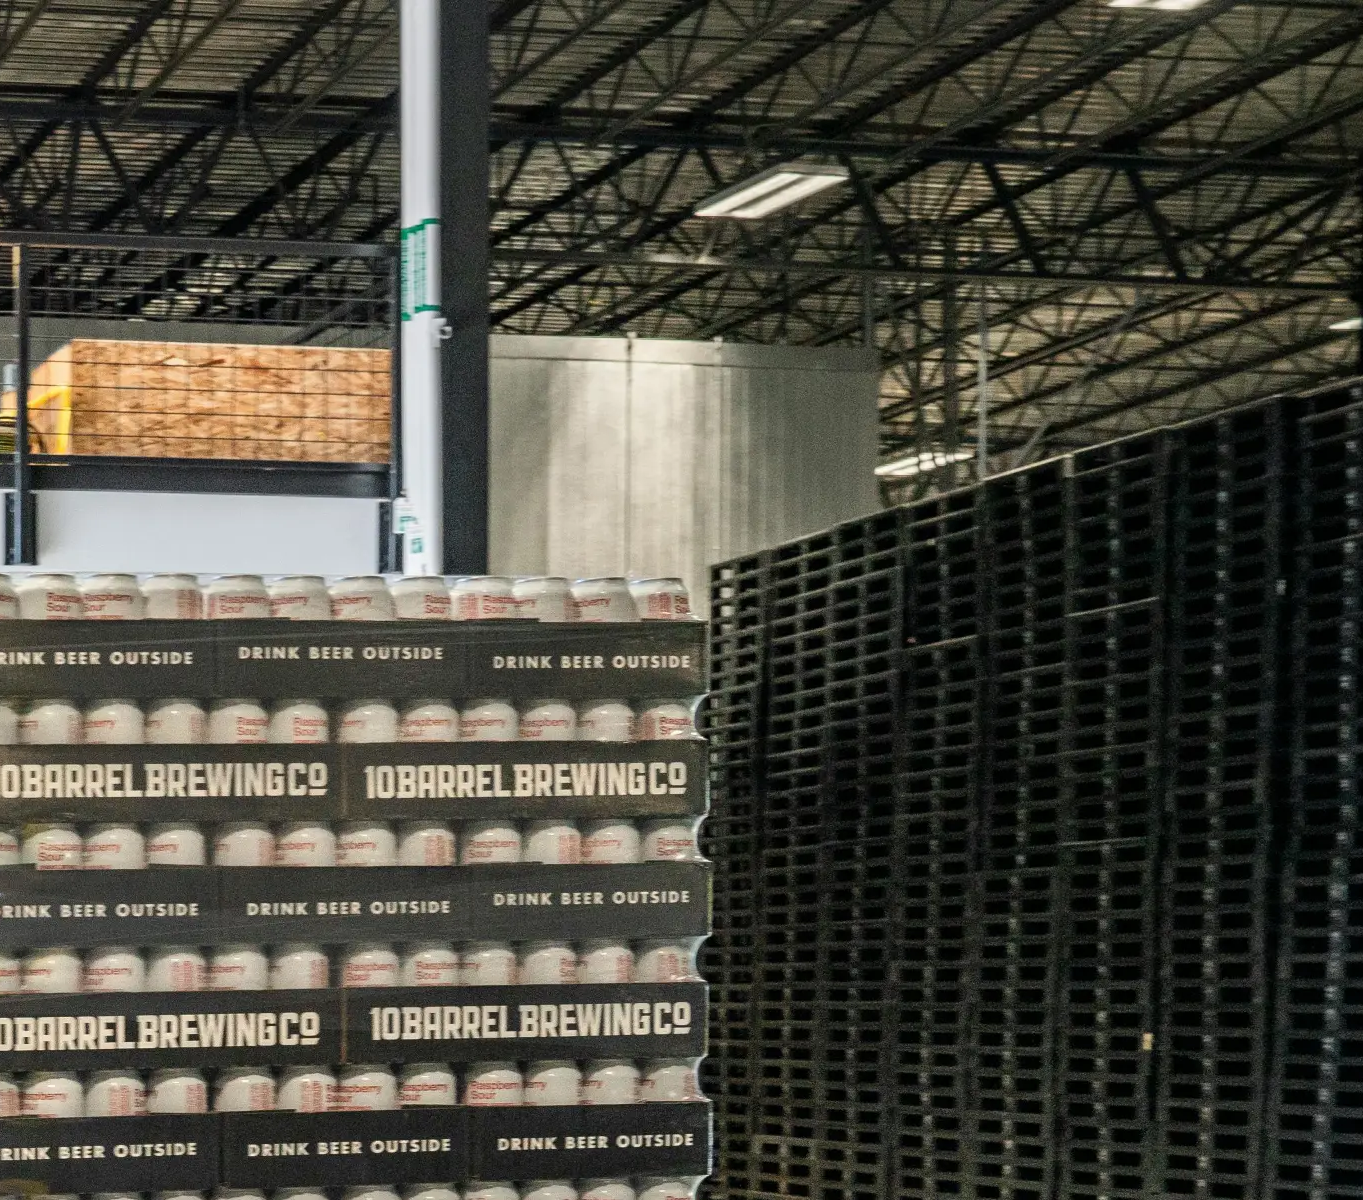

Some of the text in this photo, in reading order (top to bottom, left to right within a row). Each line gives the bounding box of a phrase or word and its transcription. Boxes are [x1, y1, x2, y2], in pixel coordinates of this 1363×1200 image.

[54, 651, 101, 665] BEER
[109, 651, 193, 665] OUTSIDE
[238, 646, 443, 660] DRINK BEER OUTSIDE
[493, 654, 691, 669] DRINK BEER OUTSIDE
[493, 890, 690, 906] DRINK BEER OUTSIDE
[60, 903, 107, 918] BEER
[115, 902, 198, 918] OUTSIDE
[247, 900, 450, 916] DRINK BEER OUTSIDE
[471, 1092, 497, 1101] Sour
[247, 1138, 451, 1157] DRINK BEER OUTSIDE
[497, 1133, 694, 1151] DRINK BEER OUTSIDE
[58, 1145, 105, 1160] BEER
[113, 1142, 197, 1158] OUTSIDE
